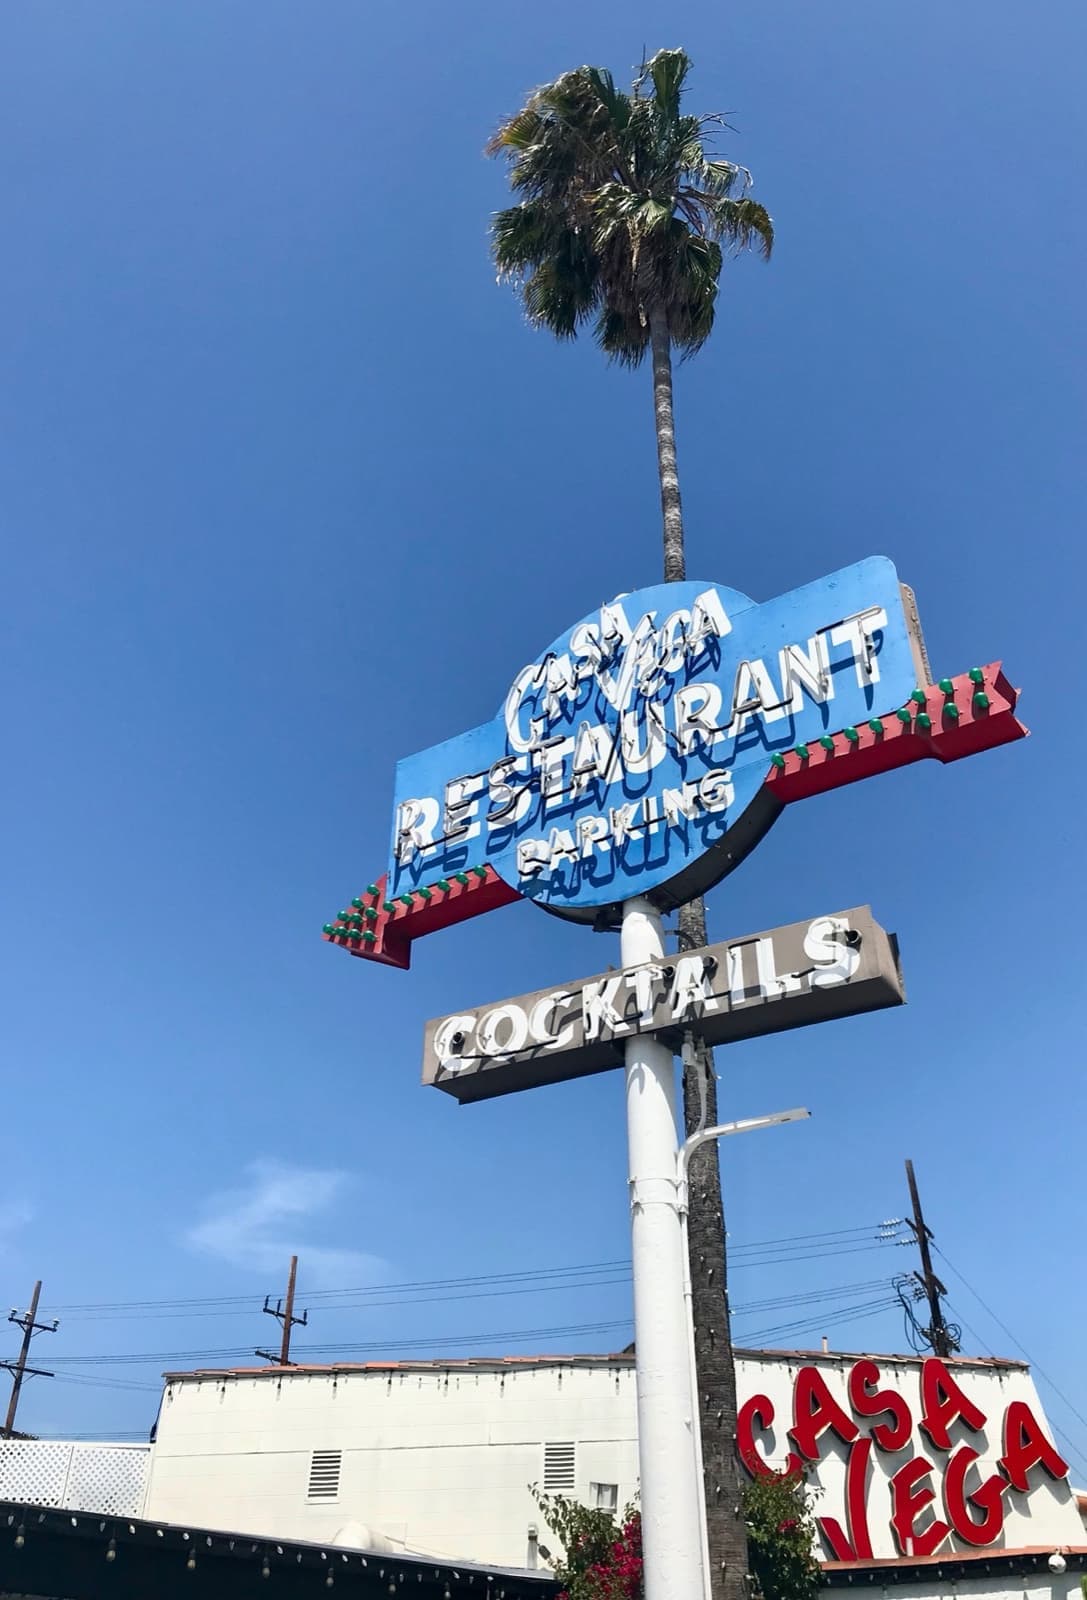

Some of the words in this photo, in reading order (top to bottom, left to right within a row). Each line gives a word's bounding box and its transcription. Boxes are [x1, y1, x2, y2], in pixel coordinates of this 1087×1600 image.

[394, 605, 889, 868] RESTAURANT
[505, 602, 633, 753] CASA
[596, 587, 733, 711] VEGA
[516, 768, 736, 882] PARKING
[433, 916, 861, 1072] COCKTAILS
[736, 1357, 988, 1487] CASA
[817, 1400, 1070, 1562] VEGA
